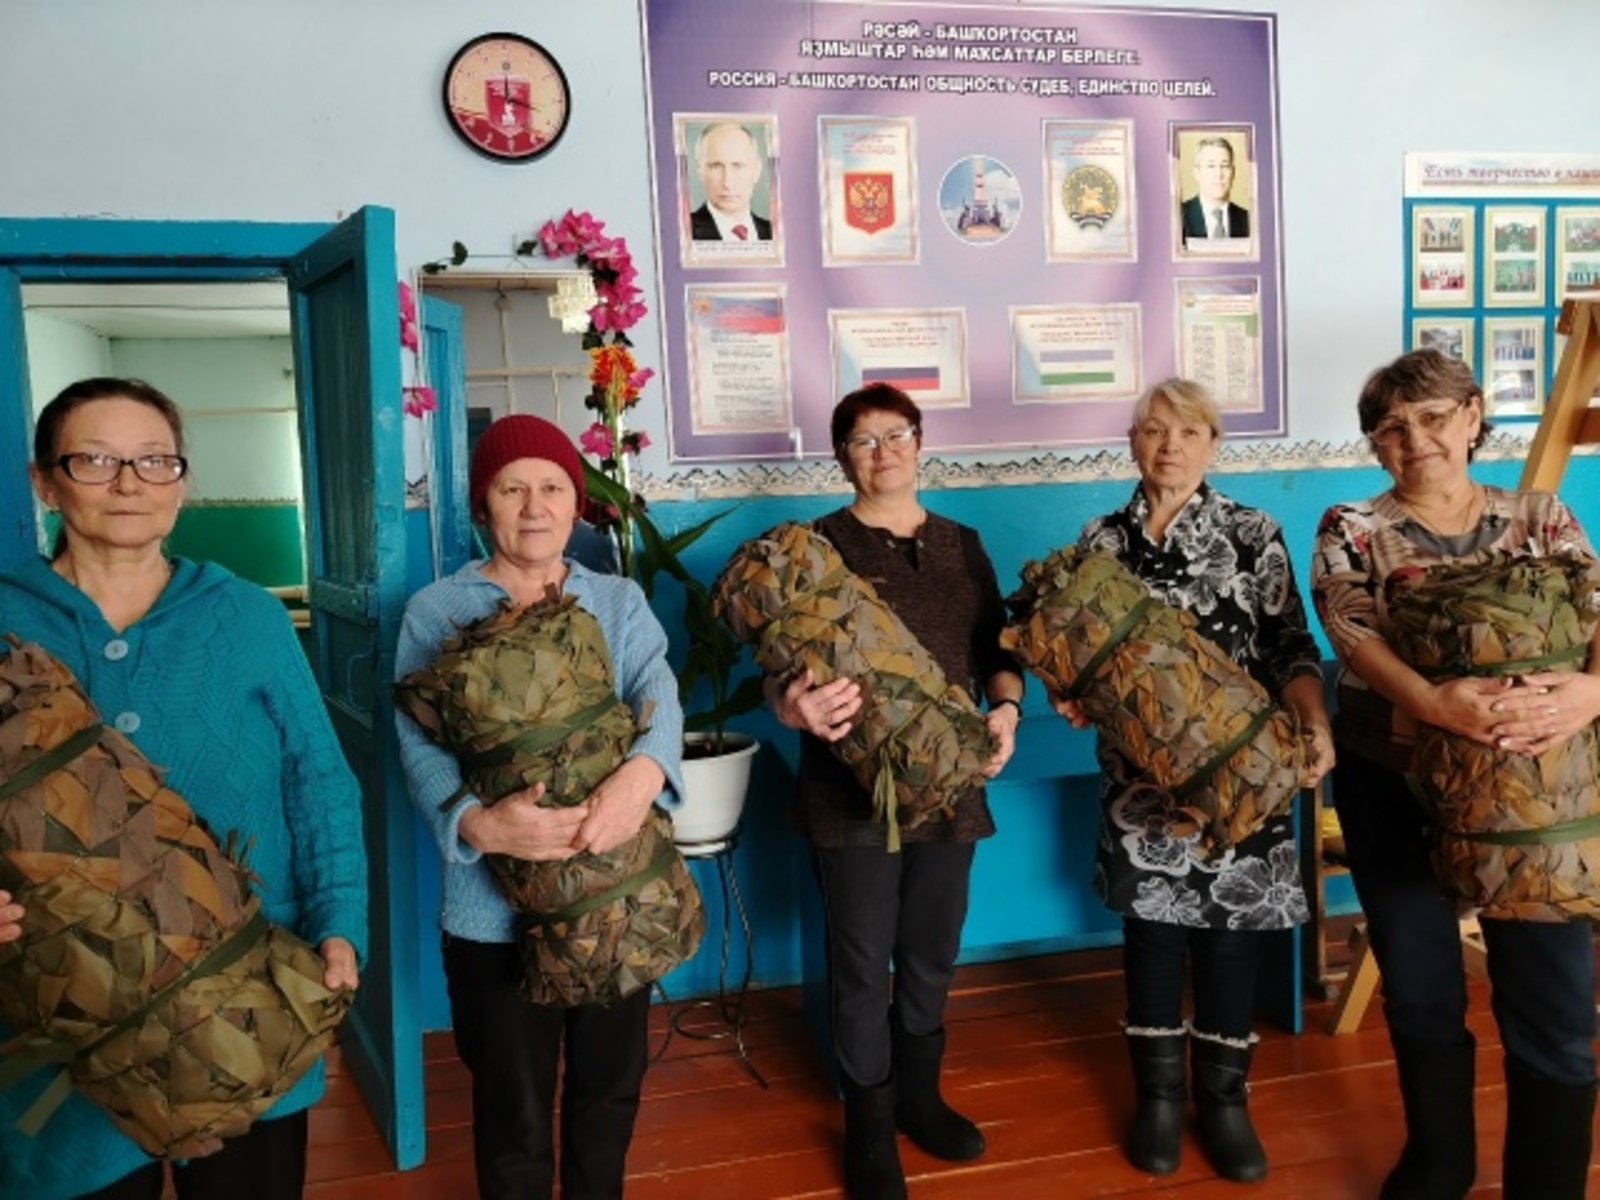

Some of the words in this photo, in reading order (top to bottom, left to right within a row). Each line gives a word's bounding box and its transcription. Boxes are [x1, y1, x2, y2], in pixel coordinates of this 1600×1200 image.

[863, 21, 920, 39] РӘСӘЙ
[708, 71, 776, 87] РОССИЯ
[789, 72, 919, 90] БАШКОРТОСТАН
[926, 76, 1016, 95] ОБЩНОСТЬ
[1020, 78, 1074, 96] СУДЕБ,
[1078, 79, 1158, 97] ЕДИНСТВО
[1163, 78, 1217, 98] ЦЕЛЕЙ.
